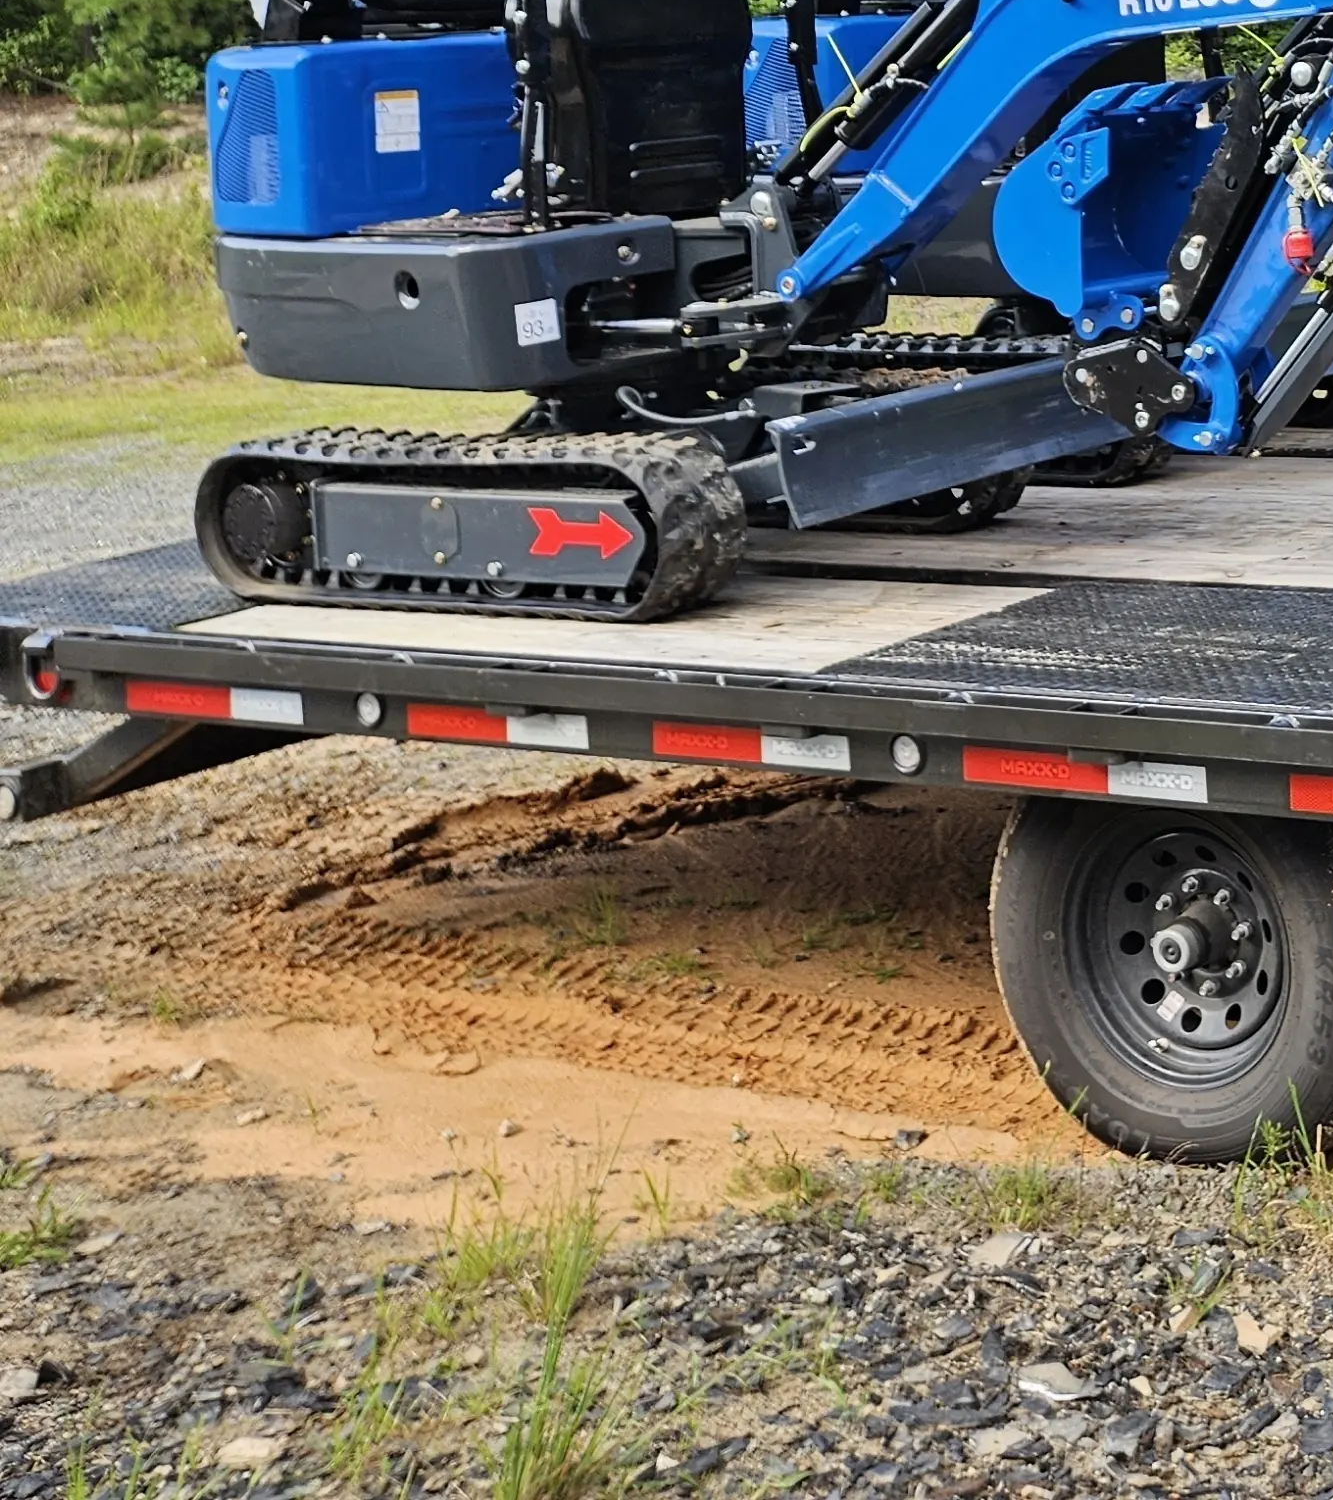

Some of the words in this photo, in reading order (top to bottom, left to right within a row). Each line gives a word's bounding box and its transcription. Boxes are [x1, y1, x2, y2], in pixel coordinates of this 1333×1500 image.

[522, 320, 544, 339] 93
[665, 730, 729, 751] MAXX-D
[1001, 759, 1071, 779] MAXX-D
[1120, 770, 1193, 791] MAXX-D
